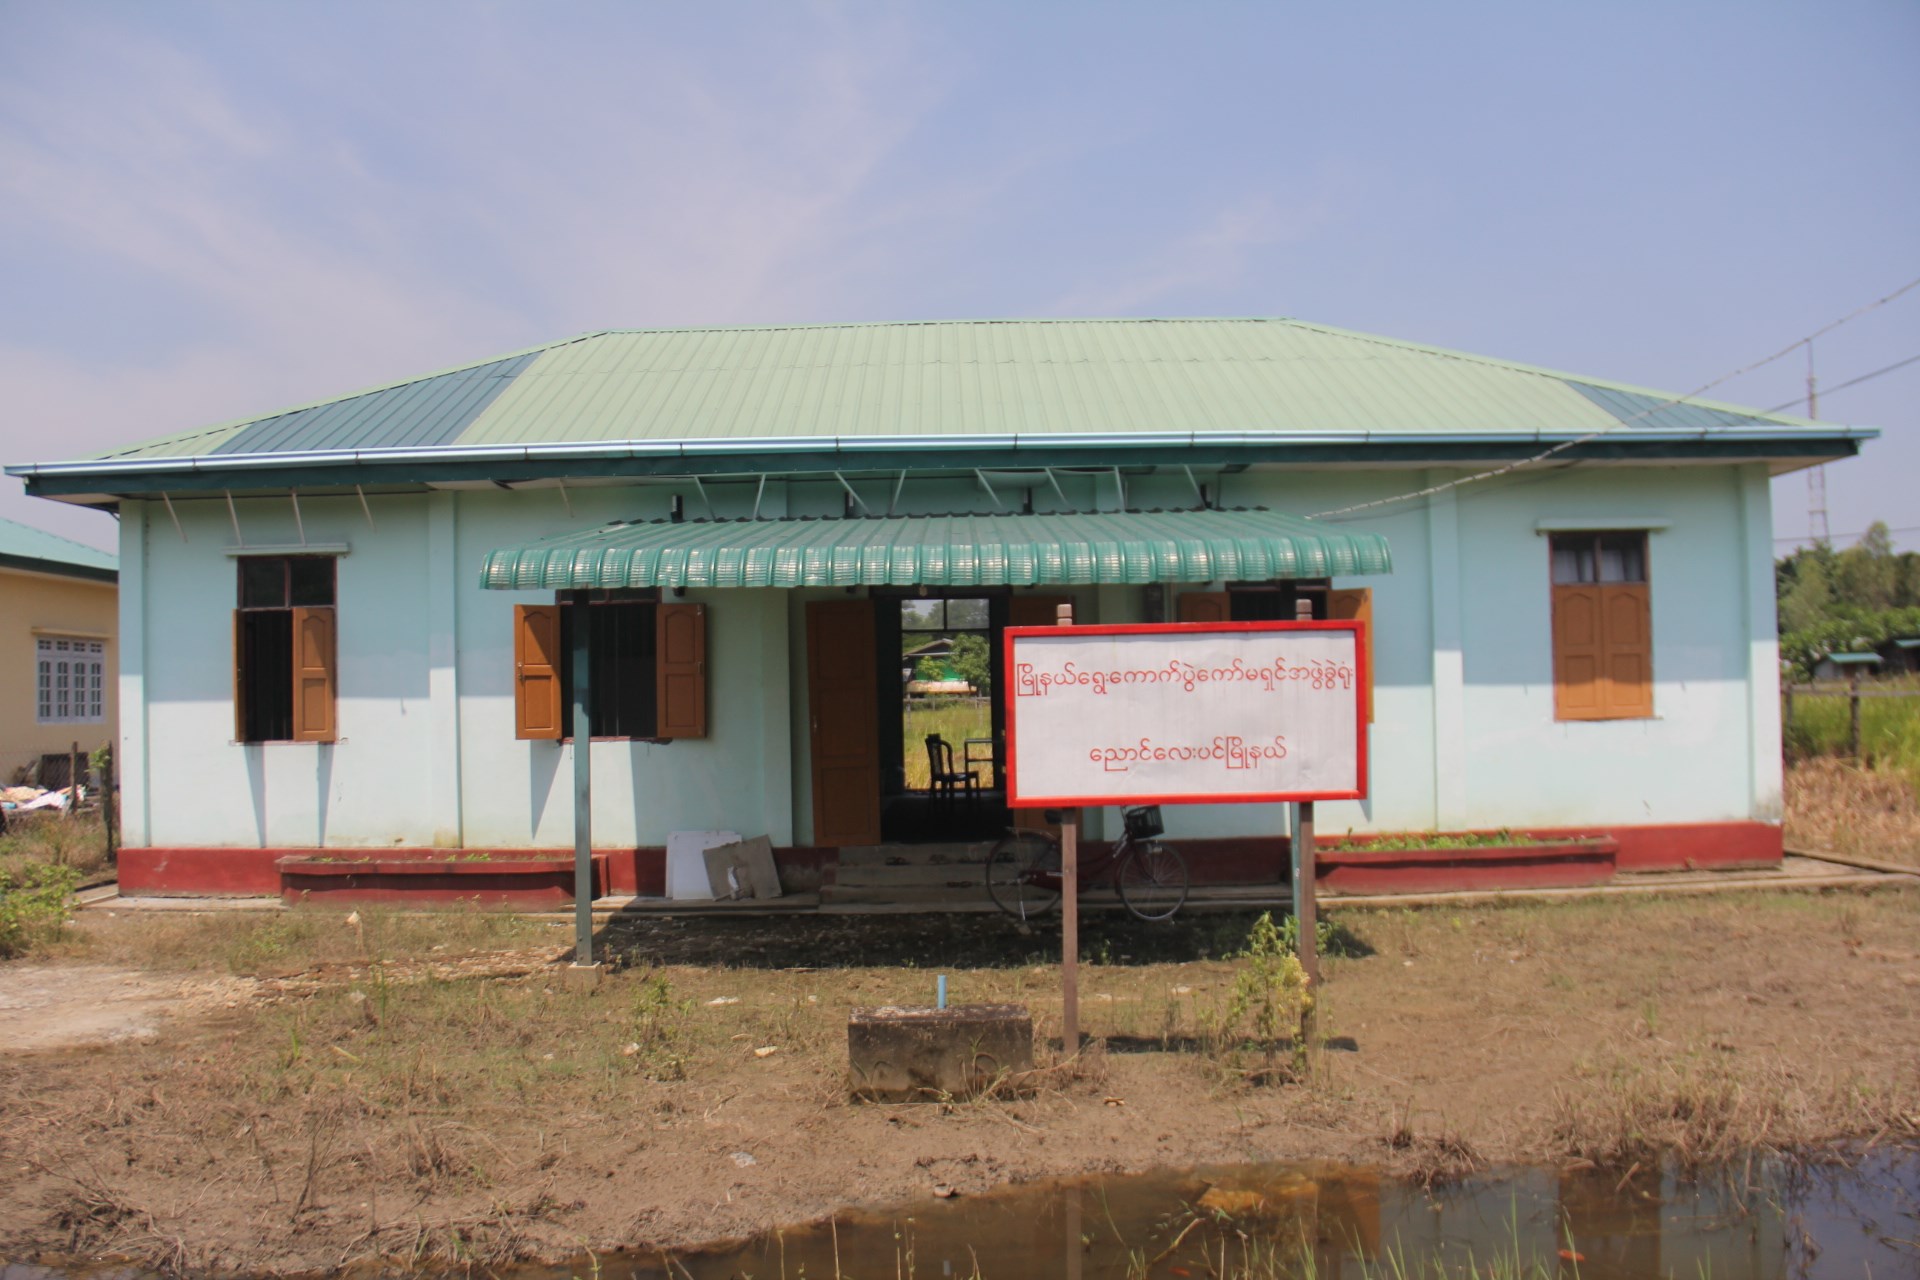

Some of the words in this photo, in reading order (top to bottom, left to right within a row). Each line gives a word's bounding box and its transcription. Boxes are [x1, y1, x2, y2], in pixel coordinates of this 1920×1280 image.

[1089, 735, 1287, 771] ညောင်လေးပင်မြို့နယ်
